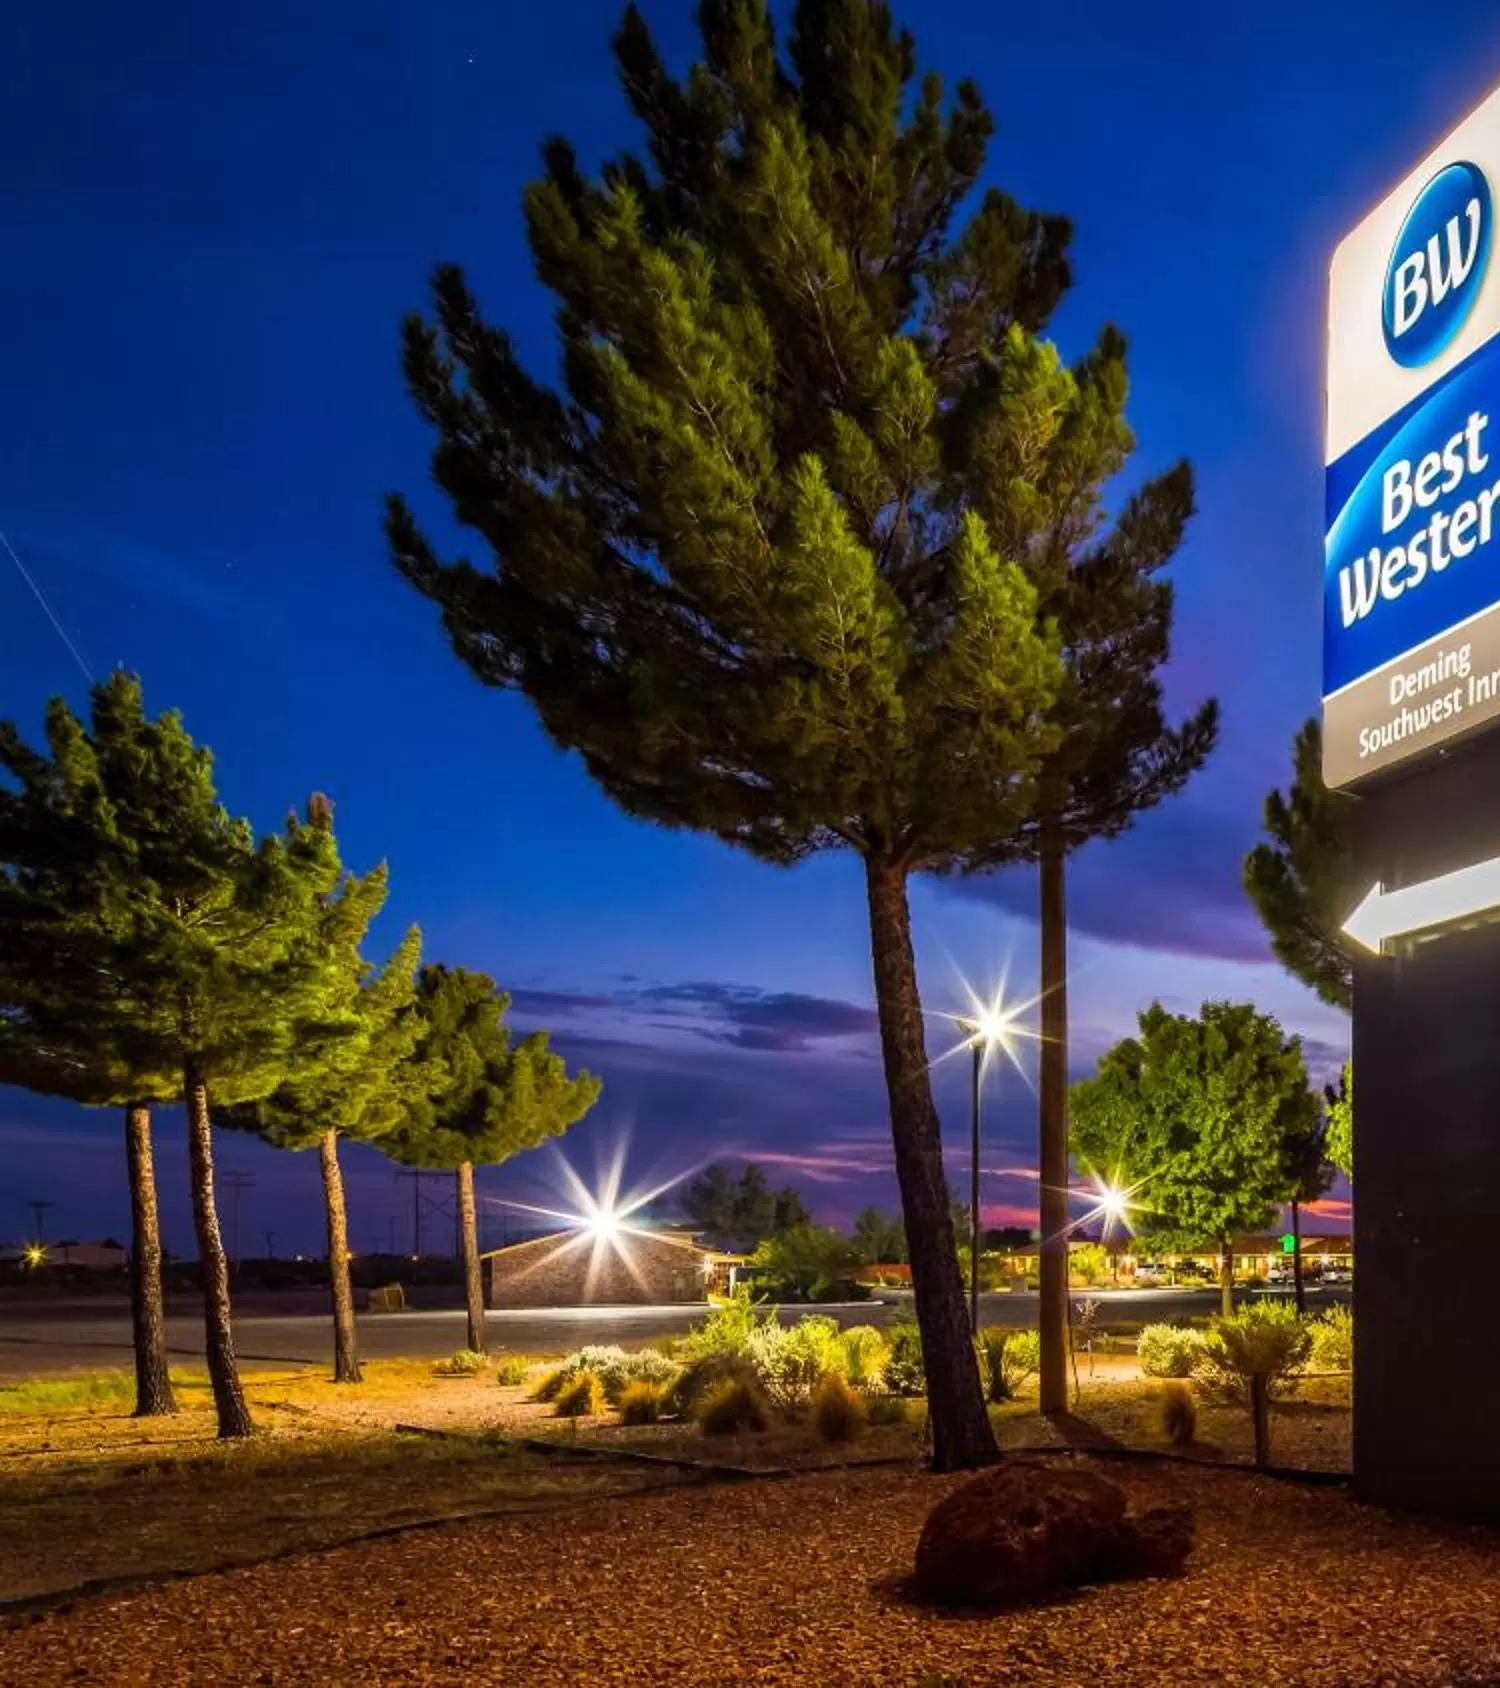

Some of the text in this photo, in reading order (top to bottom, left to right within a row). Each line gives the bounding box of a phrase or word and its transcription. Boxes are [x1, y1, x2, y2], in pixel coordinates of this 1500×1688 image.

[1394, 197, 1481, 339] BW
[1381, 411, 1489, 535] Best
[1358, 686, 1463, 758] Southwest
[1389, 643, 1471, 705] Deming
